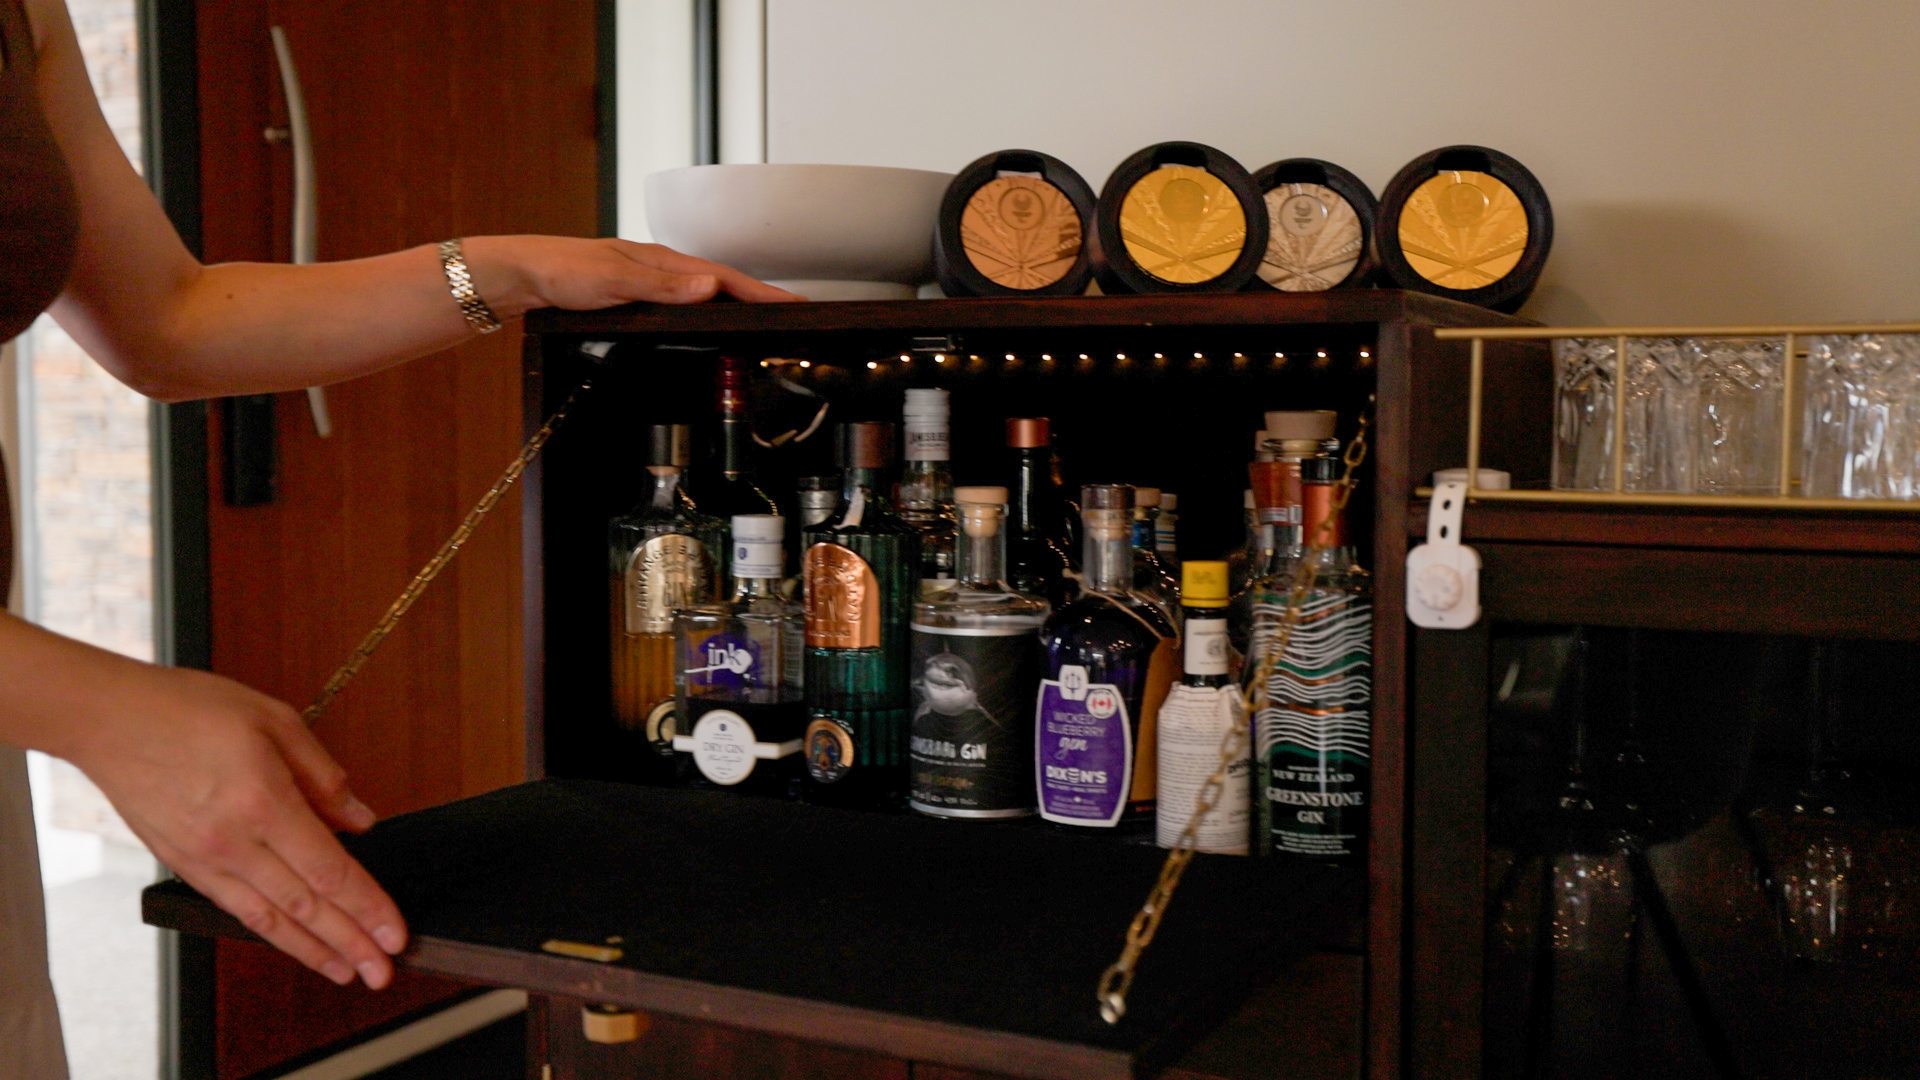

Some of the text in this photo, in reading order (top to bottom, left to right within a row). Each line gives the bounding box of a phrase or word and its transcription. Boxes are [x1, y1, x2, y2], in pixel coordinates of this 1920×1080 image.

[705, 642, 753, 675] ink
[1053, 711, 1097, 725] WICKED
[1047, 721, 1107, 737] BLUEBERRY
[703, 741, 745, 755] DRY GIN
[1054, 737, 1088, 760] gin
[1045, 764, 1108, 785] DIXON'S
[1272, 769, 1296, 780] NEW
[1298, 772, 1355, 783] ZEALAND
[1265, 786, 1365, 807] GREENSTONE
[1296, 810, 1326, 825] GIN
